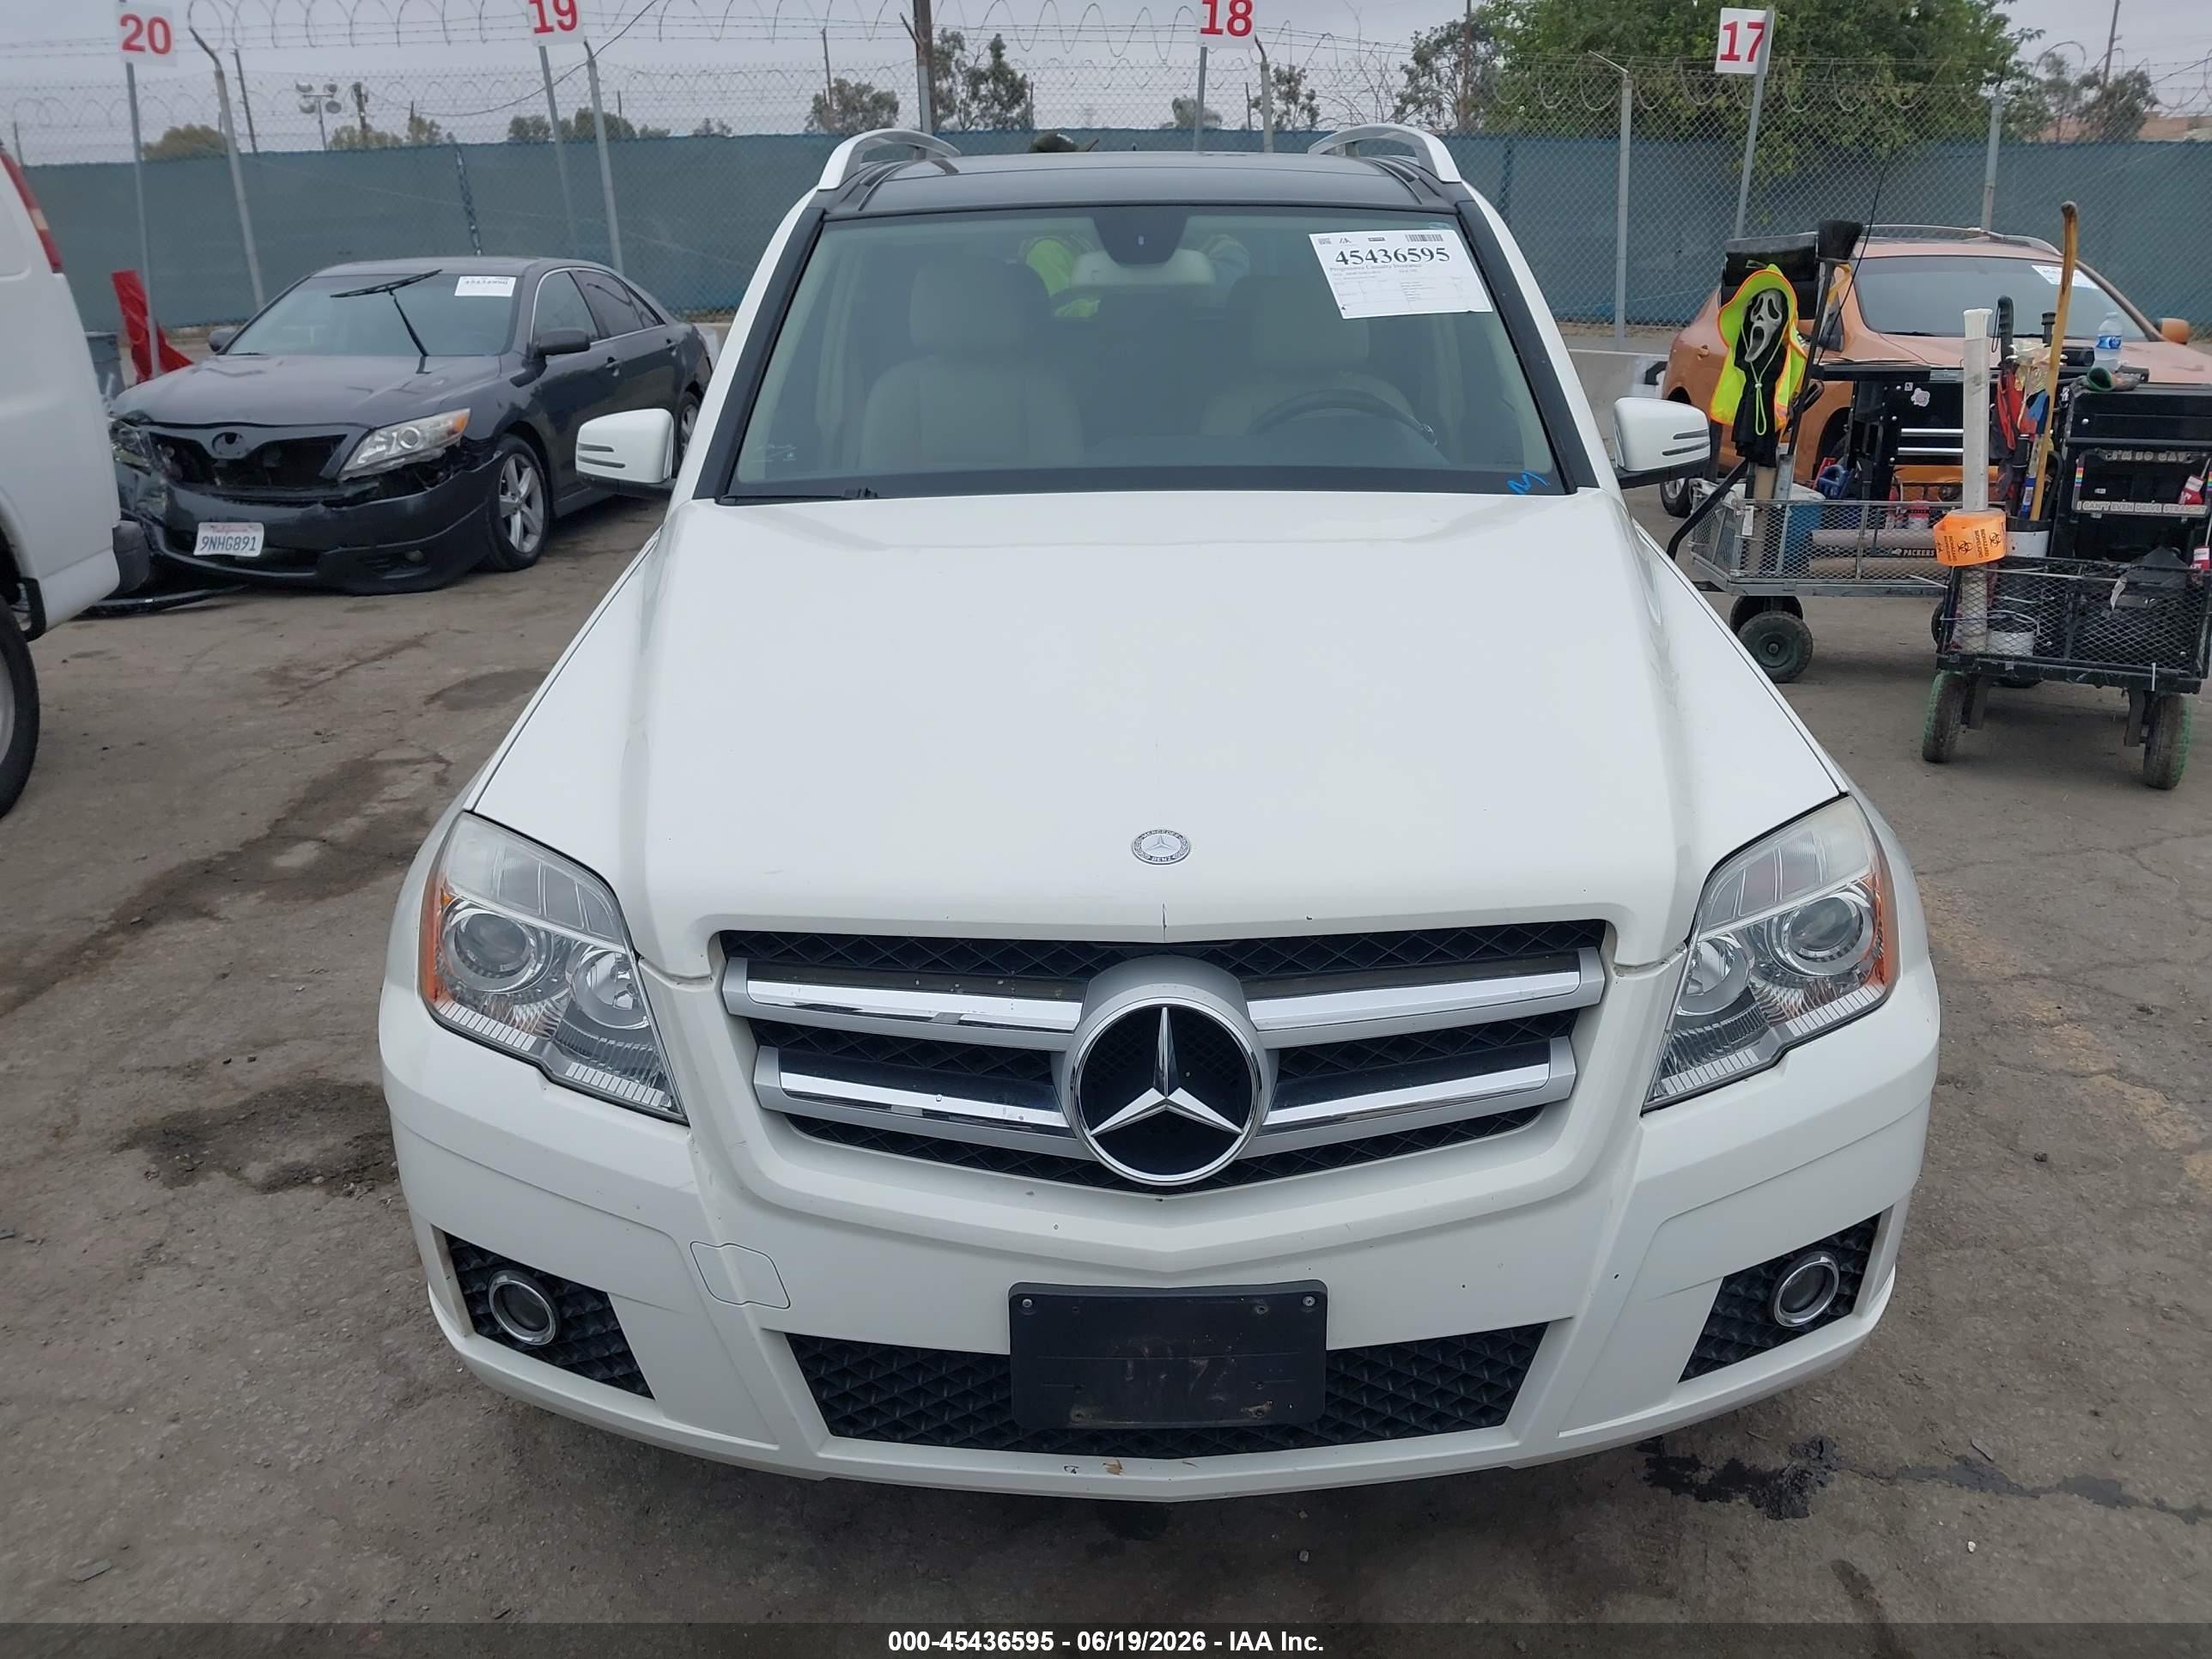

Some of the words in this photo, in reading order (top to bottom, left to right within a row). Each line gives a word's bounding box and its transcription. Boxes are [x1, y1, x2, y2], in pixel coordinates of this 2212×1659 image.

[120, 13, 172, 54] 20
[528, 0, 577, 33] 19
[1200, 0, 1252, 36] 18
[1720, 21, 1765, 62] 17
[1335, 246, 1450, 265] 45436595
[200, 536, 256, 551] 9NHG891
